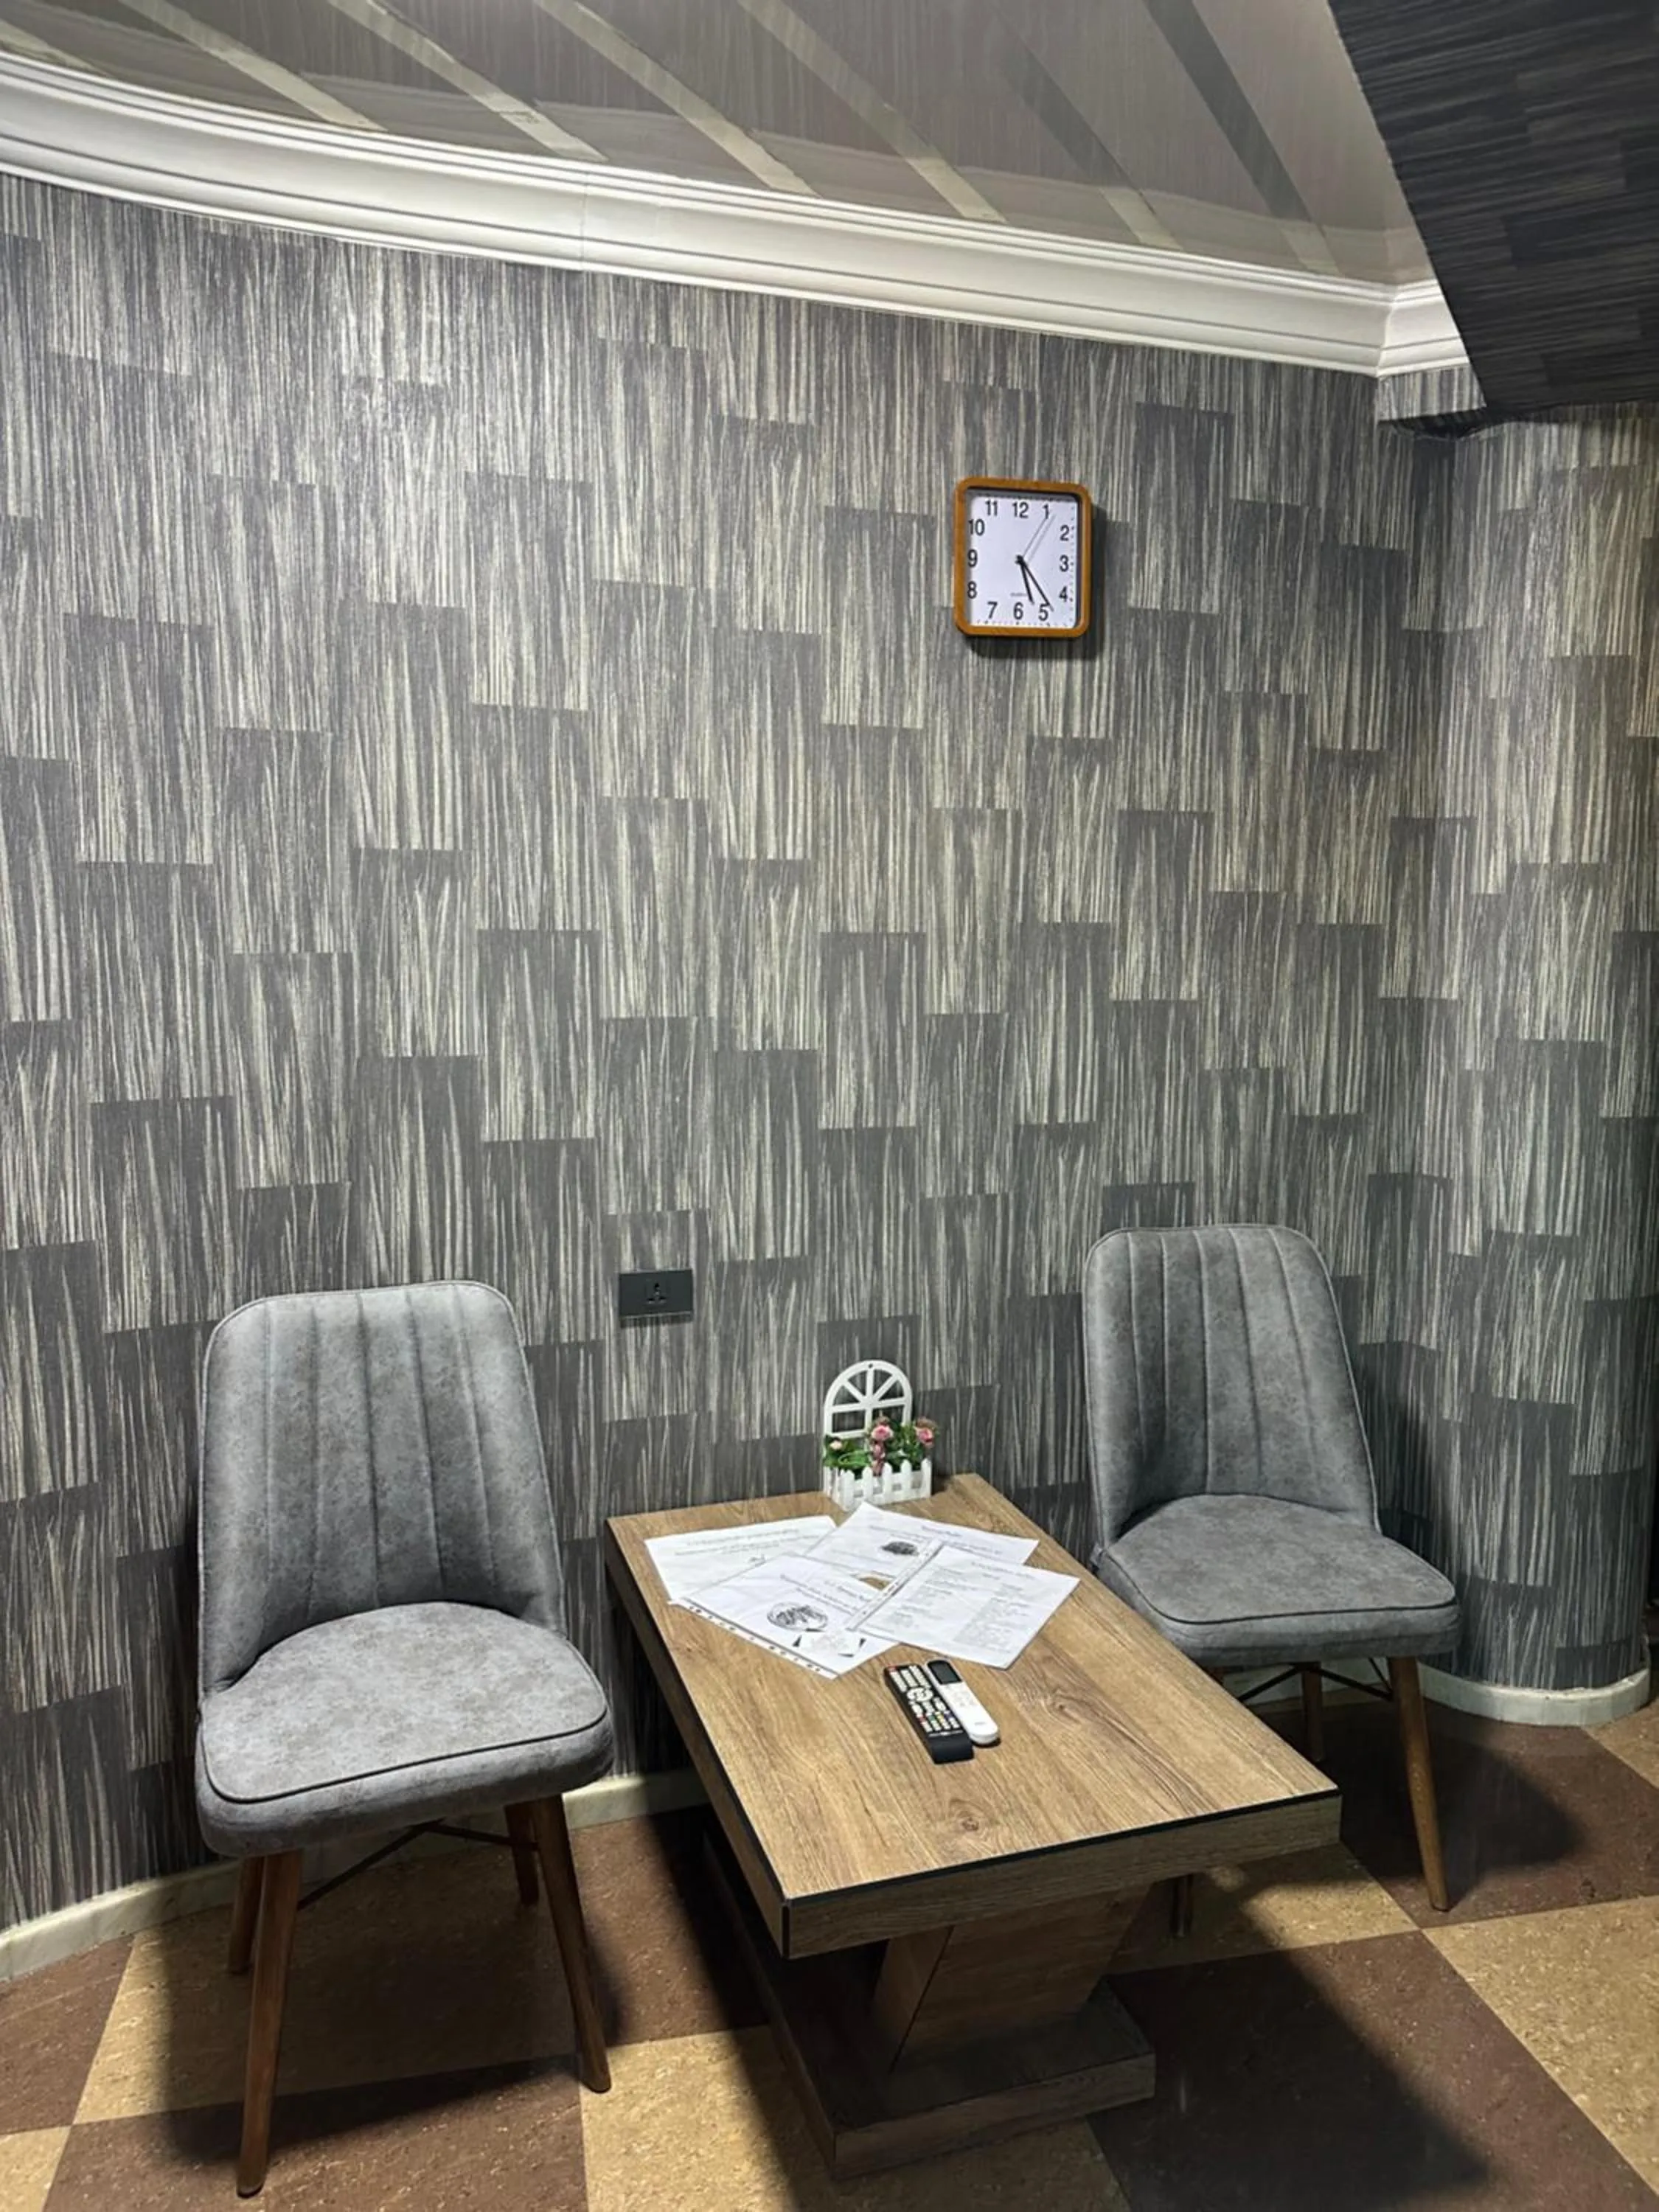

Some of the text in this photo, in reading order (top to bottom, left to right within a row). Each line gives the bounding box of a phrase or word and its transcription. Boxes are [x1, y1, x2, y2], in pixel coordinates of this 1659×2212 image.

[985, 500, 998, 516] 11
[1012, 501, 1029, 518] 12
[1043, 504, 1049, 519] 1
[968, 518, 985, 536] 10
[1060, 525, 1069, 541] 2
[967, 549, 978, 568] 9
[1060, 555, 1069, 572] 3
[967, 581, 977, 599] 8
[1059, 586, 1068, 602] 4
[987, 602, 998, 619] 7
[1013, 602, 1023, 619] 6
[1038, 603, 1049, 621] 5
